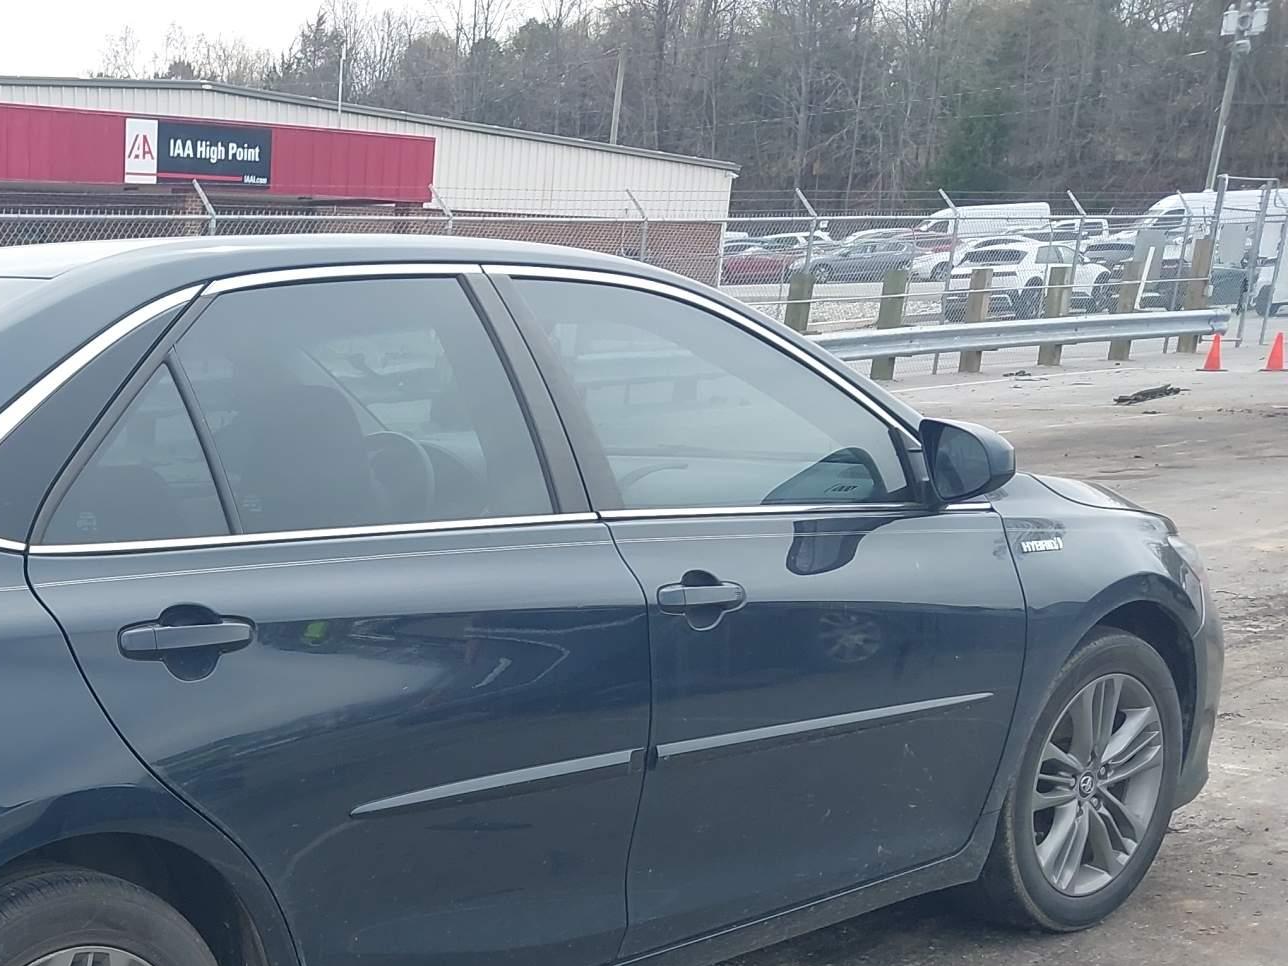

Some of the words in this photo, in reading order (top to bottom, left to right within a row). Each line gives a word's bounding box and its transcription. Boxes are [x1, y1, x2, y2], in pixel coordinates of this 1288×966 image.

[169, 138, 194, 158] IAA
[196, 140, 226, 163] High
[228, 142, 260, 162] Point
